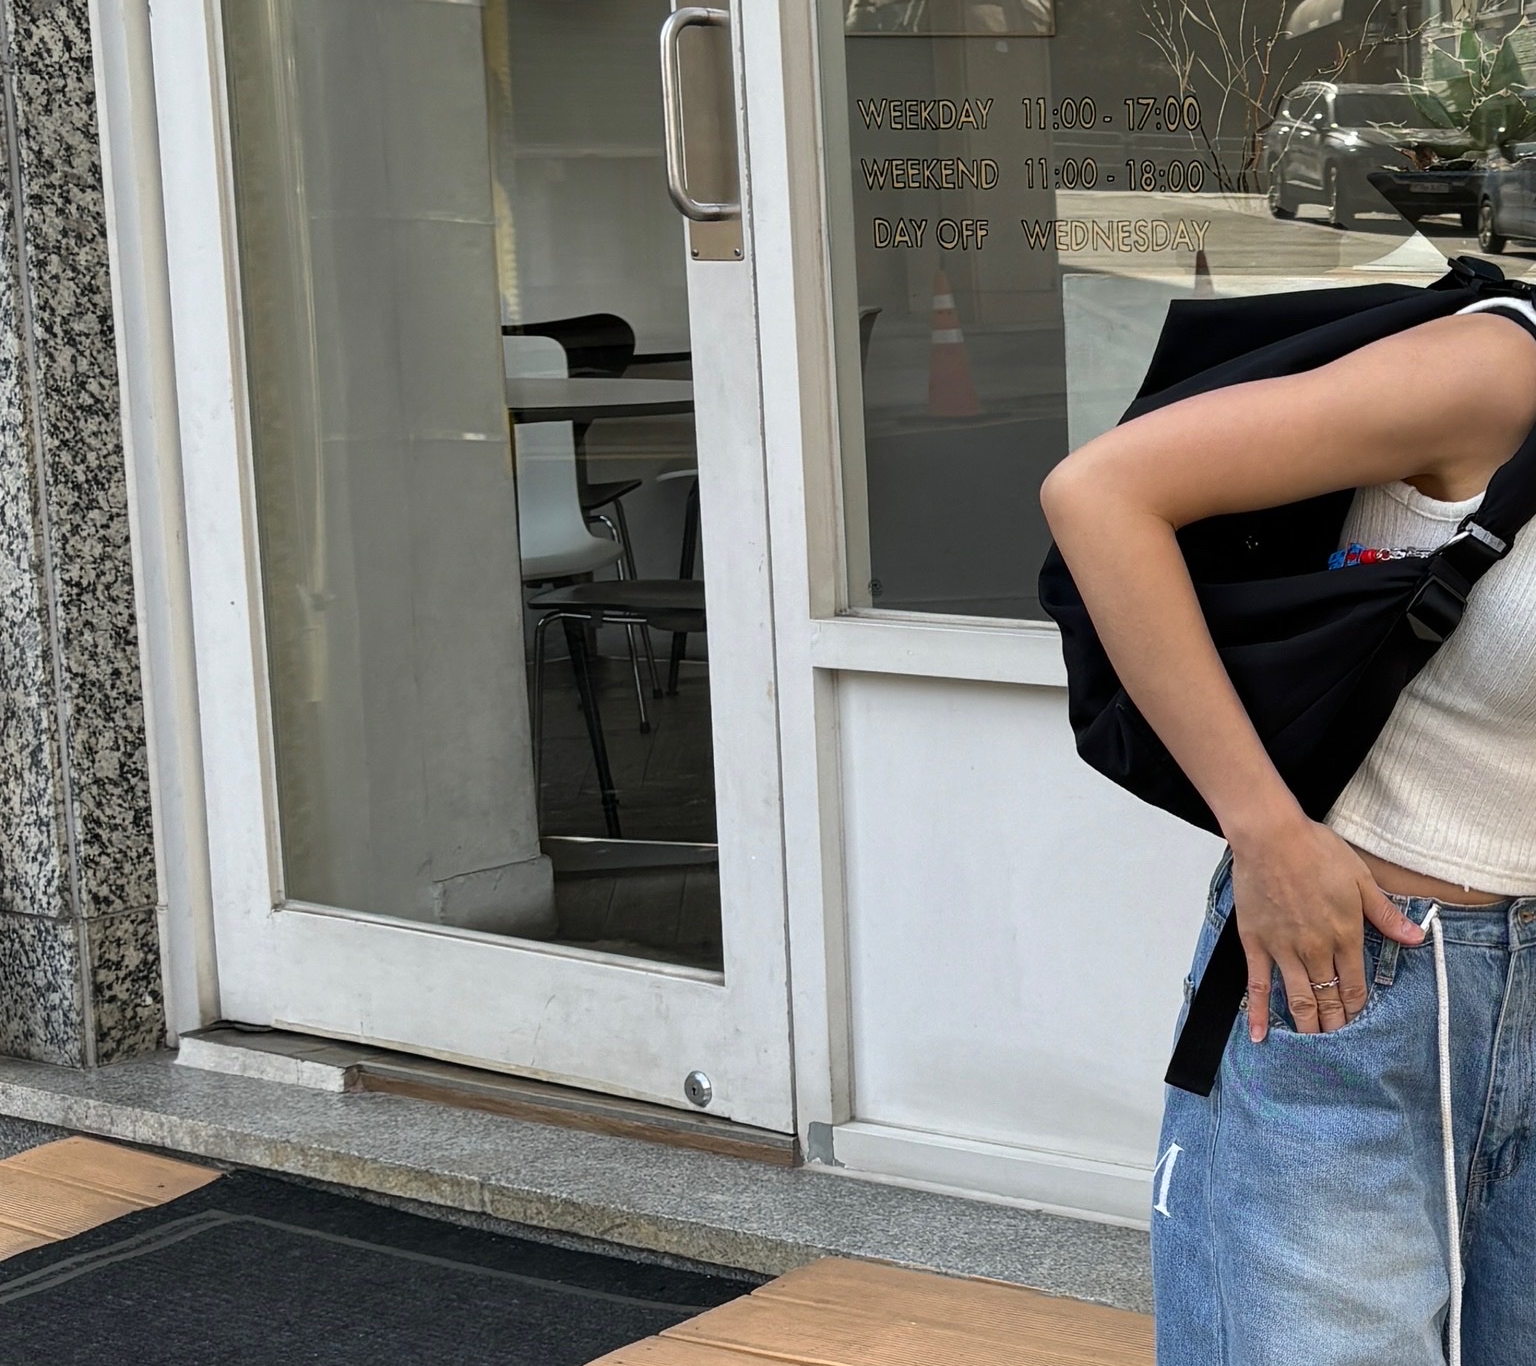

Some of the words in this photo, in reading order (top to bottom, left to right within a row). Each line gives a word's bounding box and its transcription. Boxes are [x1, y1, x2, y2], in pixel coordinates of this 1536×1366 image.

[857, 98, 994, 131] WEEKDAY
[1022, 97, 1097, 131] 11:00
[1124, 95, 1201, 132] 17:00
[860, 157, 1000, 191] WEEKEND
[1025, 157, 1099, 191] 11:00
[1126, 158, 1205, 193] 18:00
[873, 217, 928, 249] DAY
[935, 217, 989, 251] OFF
[1021, 218, 1211, 253] WEDNESDAY
